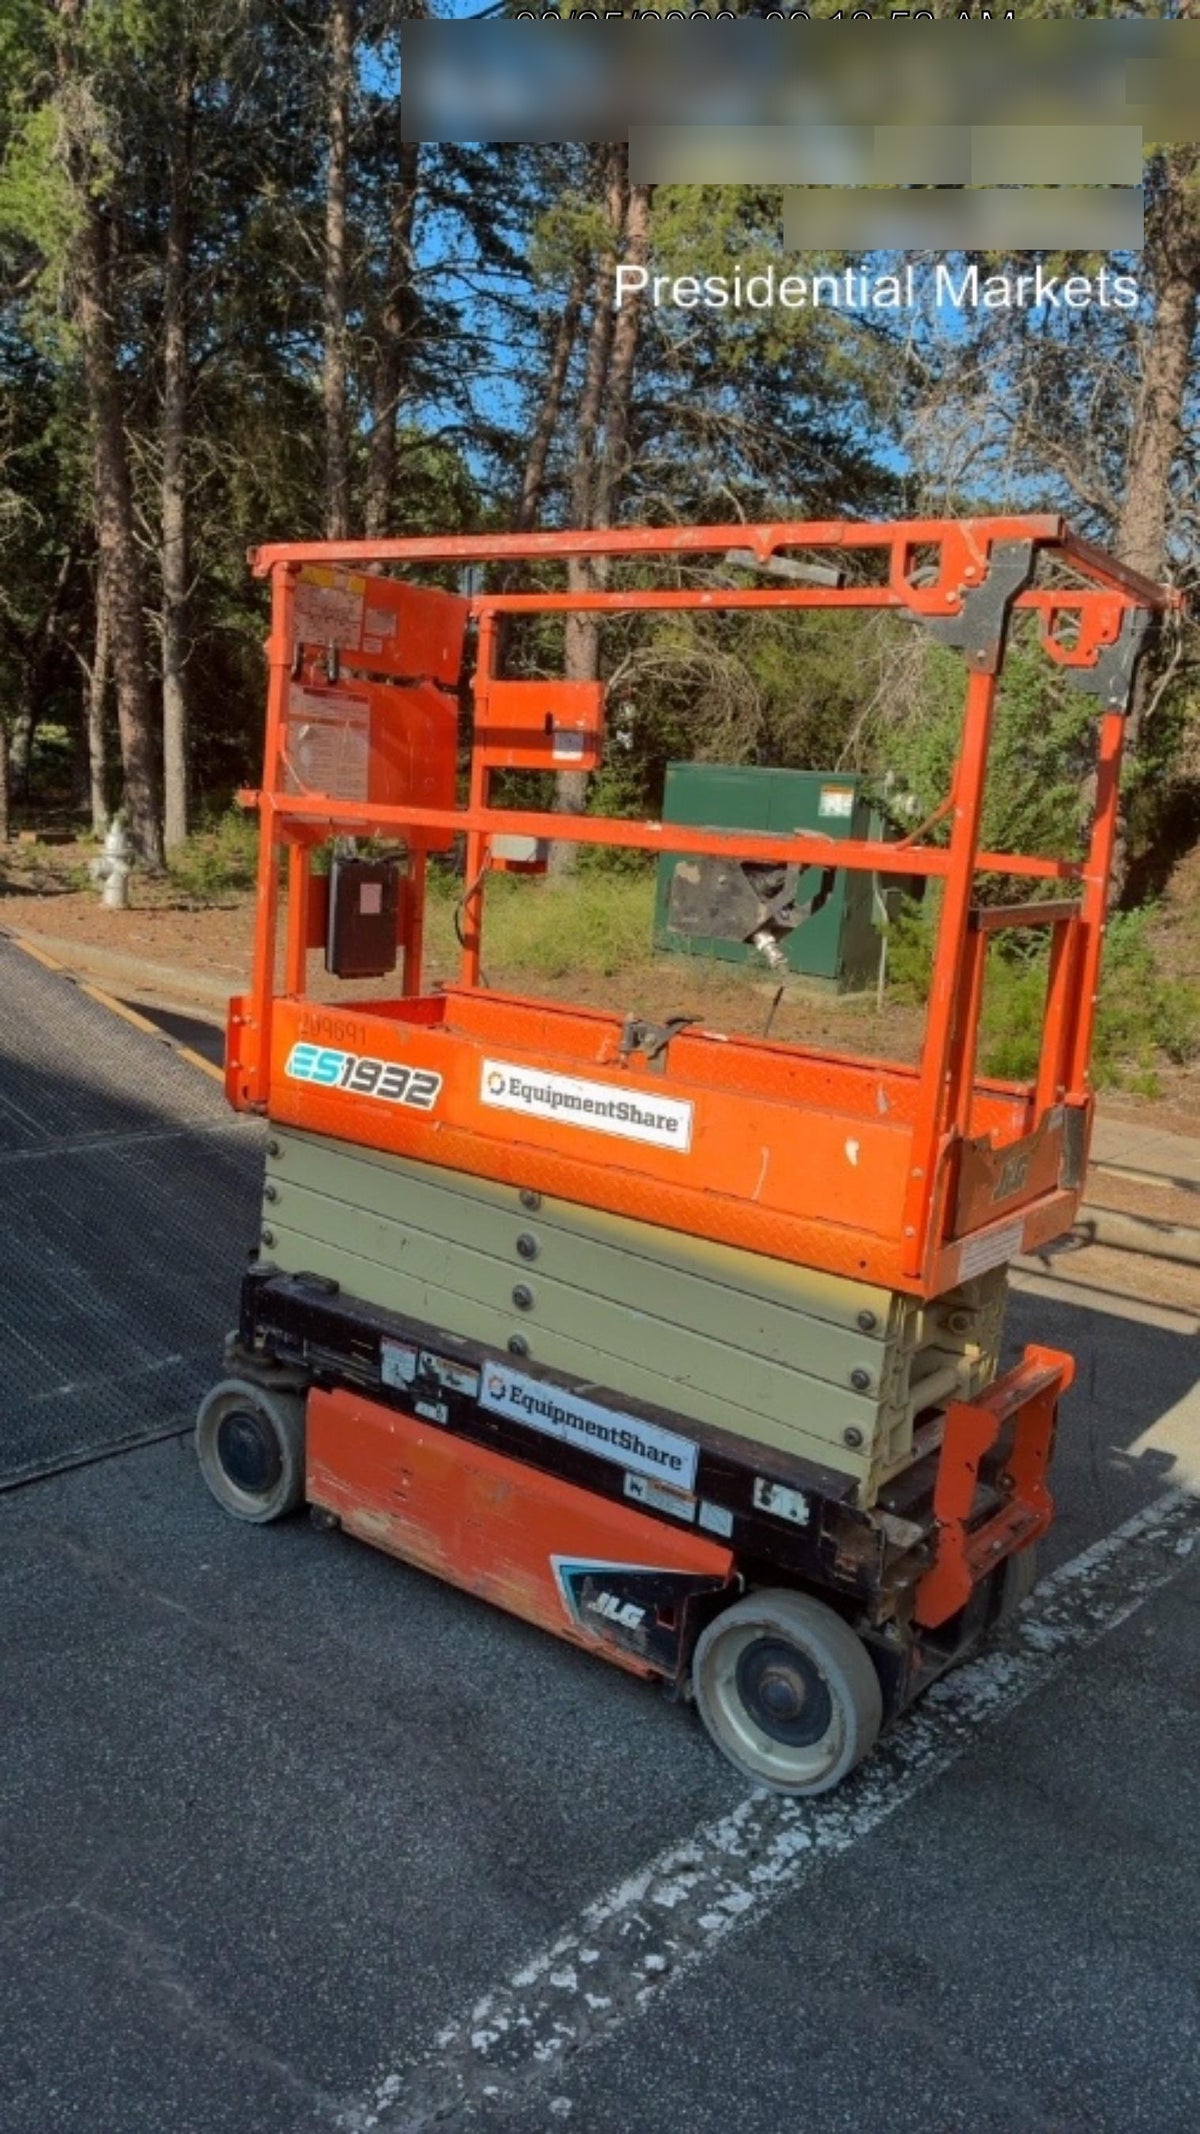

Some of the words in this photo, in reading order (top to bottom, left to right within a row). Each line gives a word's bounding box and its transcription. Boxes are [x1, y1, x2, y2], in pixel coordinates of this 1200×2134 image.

[288, 1044, 441, 1108] ES1932
[509, 1077, 679, 1132] EquipmentShare
[509, 1383, 682, 1471] EquipmentShare
[587, 1592, 646, 1630] JLG
